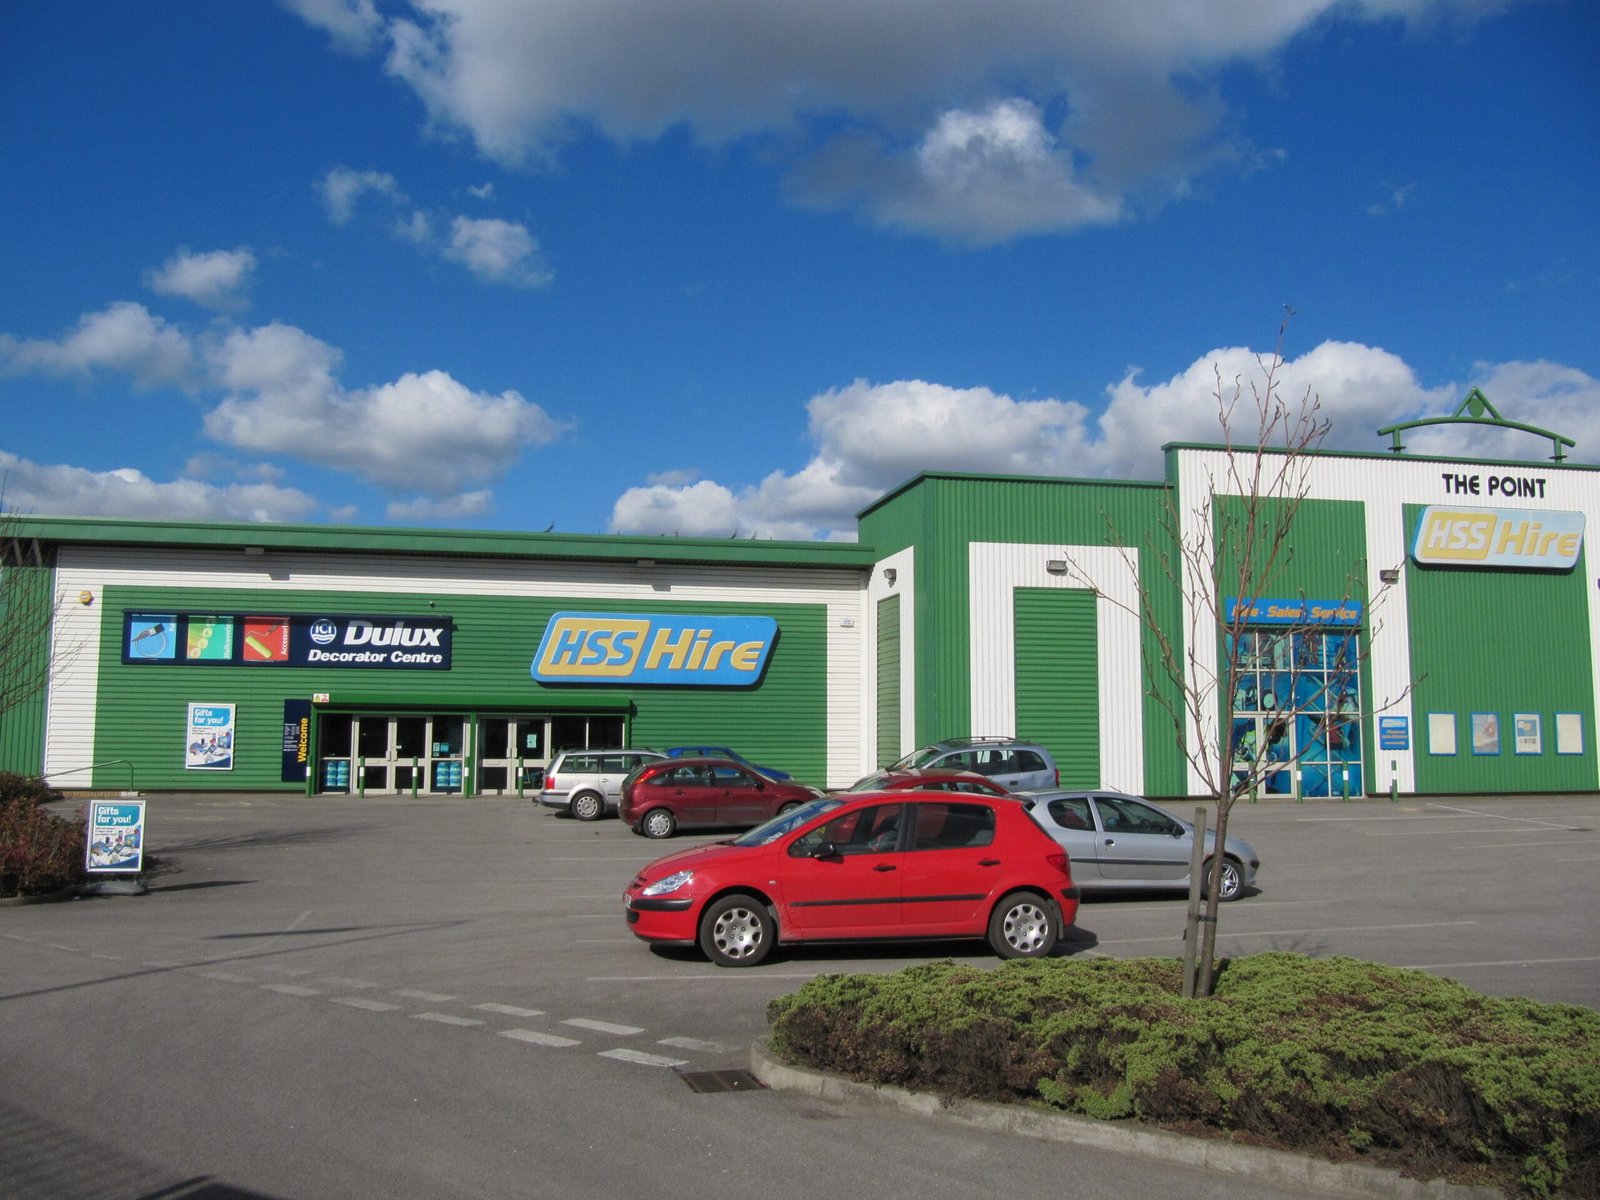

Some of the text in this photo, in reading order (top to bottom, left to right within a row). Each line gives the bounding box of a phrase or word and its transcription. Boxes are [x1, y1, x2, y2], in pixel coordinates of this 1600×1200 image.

[1442, 473, 1546, 499] THE POINT
[1427, 519, 1580, 557] HSS Hire
[343, 620, 443, 647] Dulux
[308, 649, 443, 664] Decorator Centre
[551, 628, 765, 671] HSS Hire
[194, 716, 224, 725] for you!
[298, 717, 309, 763] Welcome
[97, 815, 132, 825] for you!
[98, 806, 119, 815] Gifts
